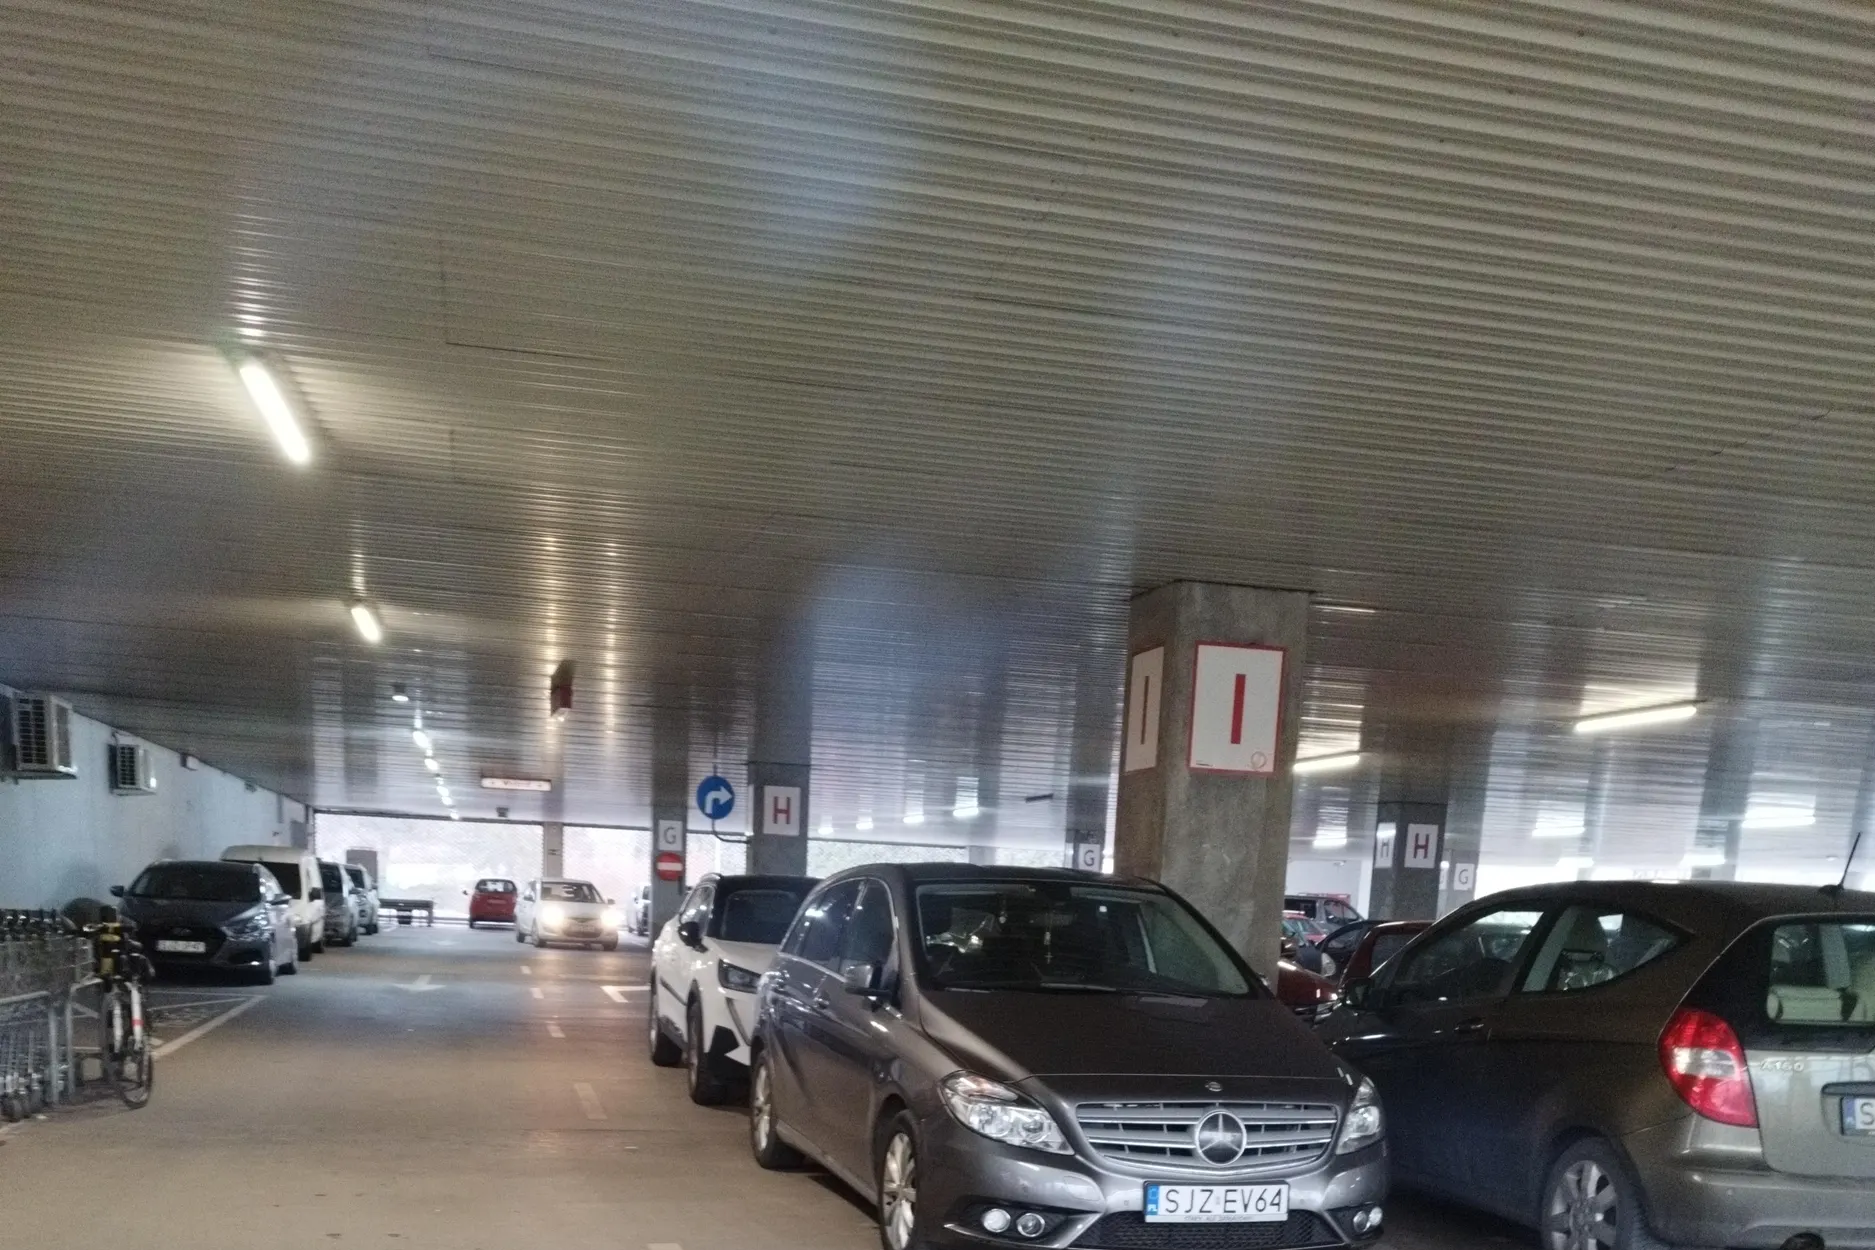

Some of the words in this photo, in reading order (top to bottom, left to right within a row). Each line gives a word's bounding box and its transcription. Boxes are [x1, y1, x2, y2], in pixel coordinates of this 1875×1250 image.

[1230, 673, 1246, 744] I
[773, 797, 791, 824] H
[663, 826, 677, 845] G
[1413, 833, 1430, 859] H
[1084, 850, 1095, 866] G
[1458, 868, 1469, 885] G
[1165, 1189, 1214, 1213] SJZ
[1224, 1188, 1282, 1213] EV64
